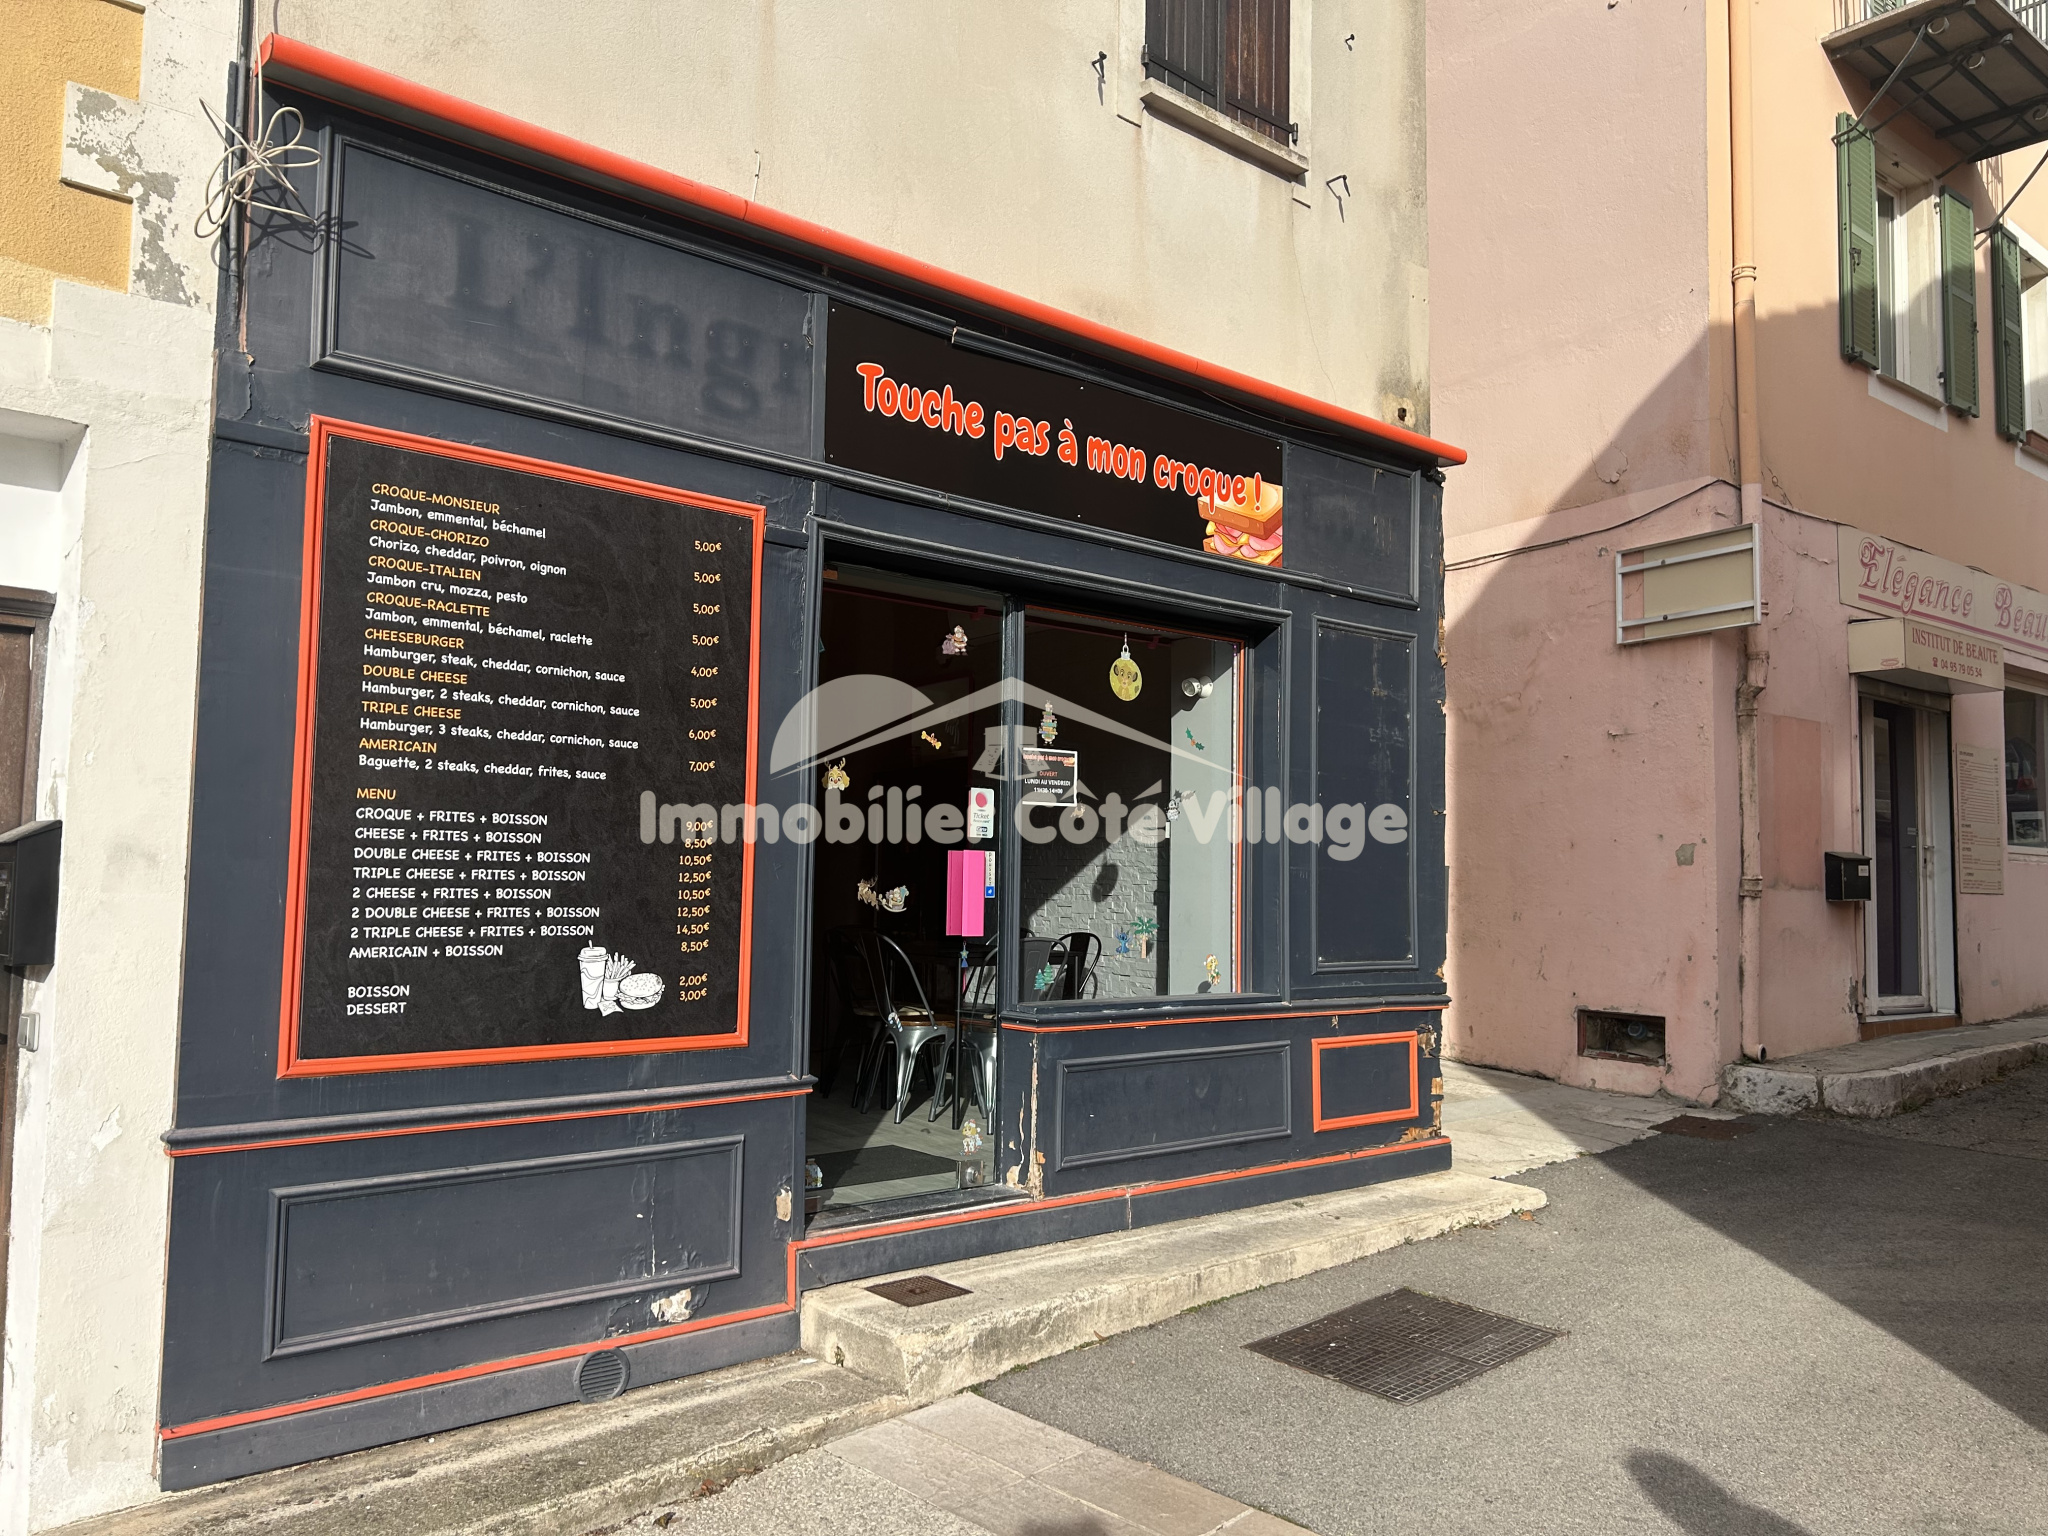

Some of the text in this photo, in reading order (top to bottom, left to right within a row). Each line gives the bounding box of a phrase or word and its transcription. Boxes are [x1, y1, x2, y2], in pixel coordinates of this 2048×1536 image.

[856, 362, 1264, 513] Touche pas à mon croque !
[371, 483, 500, 515] CROQUE-MONSIEUR
[370, 498, 545, 539] Jambon, emmental, béchamel
[370, 519, 489, 547] CROQUE-CHORIZO
[694, 540, 721, 552] 5,00€
[369, 535, 566, 575] Chorizo, cheddar, poivron, oignon
[368, 555, 480, 581] CROQUE-ITALIEN
[694, 571, 720, 583] 5,00€
[366, 571, 527, 603] Jambon cru, mozza, pesto
[1858, 536, 2048, 642] Elégance Beau
[366, 591, 490, 617] CROQUE-RACLETTE
[693, 603, 720, 615] 5,00€
[364, 607, 592, 645] Jambon, emmental, béchamel, raclette
[364, 627, 464, 649] CHEESEBURGER
[692, 634, 719, 646] 5,00€
[1912, 627, 1999, 665] INSTITUT DE BEAUTE
[363, 644, 625, 682] Hamburger, steak, cheddar, cornichon, sauce
[1940, 659, 1949, 670] 04
[1958, 663, 1966, 675] 79
[362, 664, 467, 684] DOUBLE CHEESE
[690, 666, 718, 677] 4,00€
[361, 680, 639, 716] Hamburger, 2 steaks, cheddar, cornichon, sauce
[690, 697, 717, 708] 5,00€
[361, 700, 461, 719] TRIPLE CHEESE
[360, 717, 638, 749] Hamburger, 3 steaks, cheddar, cornichon, sauce
[688, 729, 716, 740] 6,00€
[359, 737, 437, 753] AMERICAIN
[358, 754, 606, 780] Baguette, 2 steaks, cheddar, frites, sauce
[688, 760, 715, 772] 7,00€
[356, 787, 396, 800] MENU
[355, 807, 547, 825] CROQUE + FRITES + BOISSON
[973, 812, 990, 820] Ticket
[686, 819, 713, 832] 9,00€
[354, 827, 541, 843] CHEESE + FRITES + BOISSON
[685, 836, 712, 848] 8,50€
[353, 846, 590, 863] DOUBLE CHEESE + FRITES + BOISSON
[679, 853, 712, 866] 10,50€
[353, 866, 585, 881] TRIPLE CHEESE + FRITES + BOISSON
[678, 870, 711, 883] 12,50€
[352, 887, 551, 899] 2 CHEESE + FRITES + BOISSON
[678, 887, 711, 901] 10,50€
[351, 906, 599, 918] 2 DOUBLE CHEESE + FRITES + BOISSON
[677, 905, 710, 918] 12,50€
[350, 925, 593, 938] 2 TRIPLE CHEESE + FRITES + BOISSON
[676, 922, 709, 935] 14,50€
[348, 944, 503, 958] AMERICAIN + BOISSON
[680, 939, 709, 952] 8,50€
[679, 973, 707, 987] 2,00€
[347, 984, 409, 998] BOISSON
[679, 987, 707, 1001] 3,00€
[346, 1001, 406, 1015] DESSERT
